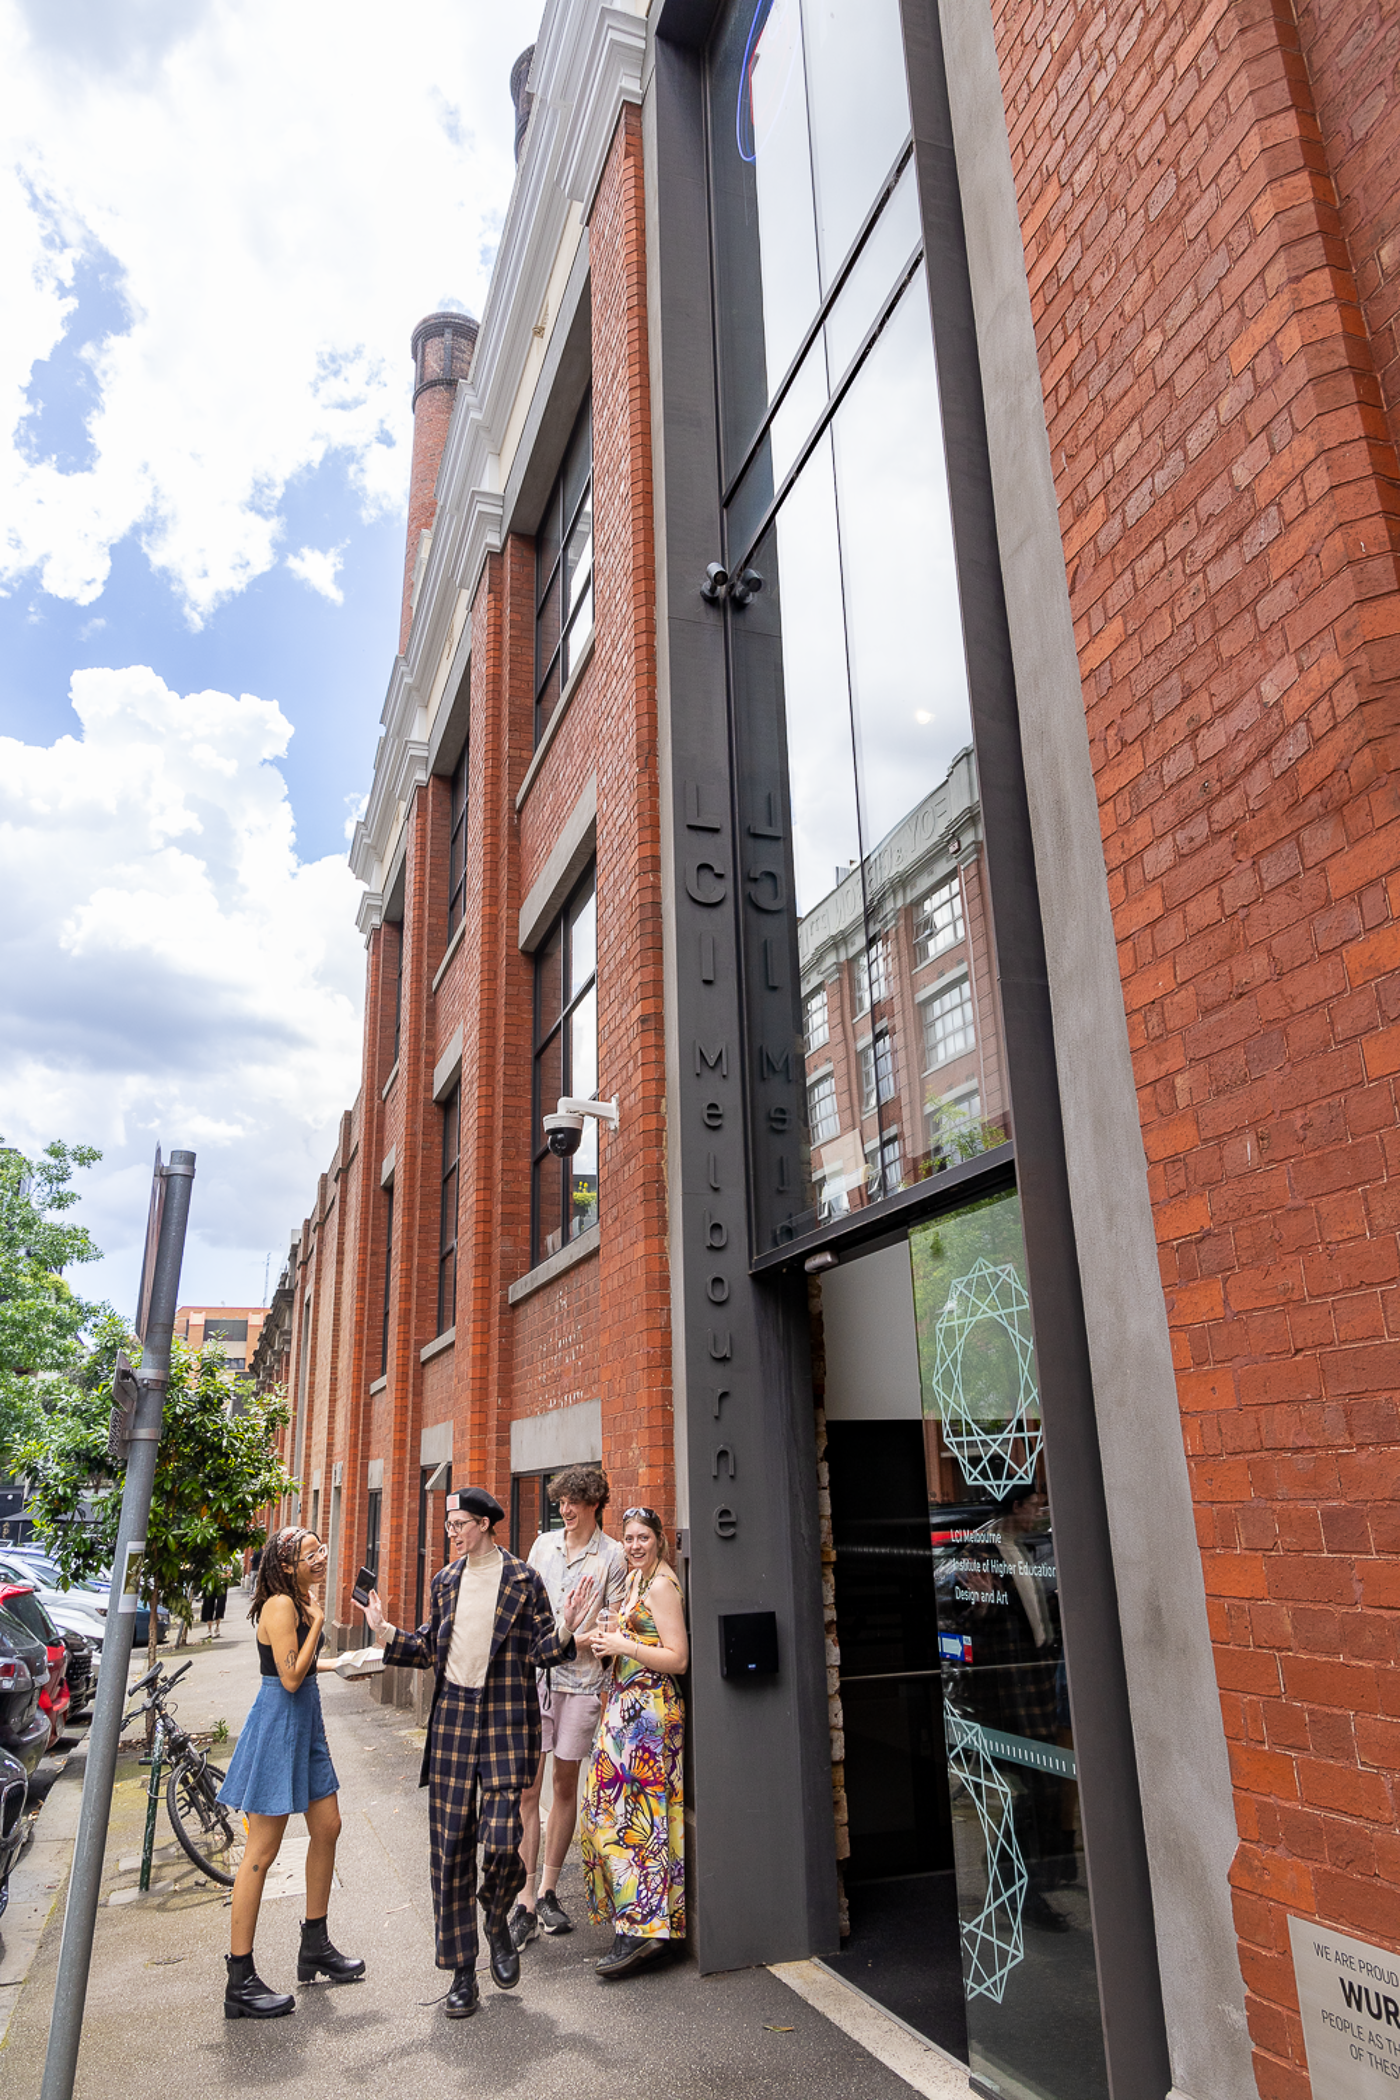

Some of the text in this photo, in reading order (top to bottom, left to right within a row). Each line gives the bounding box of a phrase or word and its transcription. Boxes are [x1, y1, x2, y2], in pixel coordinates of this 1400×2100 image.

[684, 779, 738, 1539] LCI Melbourne
[950, 1528, 1002, 1544] LCI Melbourne
[952, 1558, 981, 1573] Institute
[982, 1560, 990, 1573] of
[991, 1560, 1016, 1578] Higher
[954, 1586, 1009, 1605] Design and Art
[1313, 1941, 1399, 1988] WE ARE PROUD
[1338, 1976, 1400, 2030] WUR
[1321, 2009, 1365, 2042] PEOPLE
[1368, 2030, 1384, 2051] AS
[1350, 2043, 1400, 2080] OF THES
